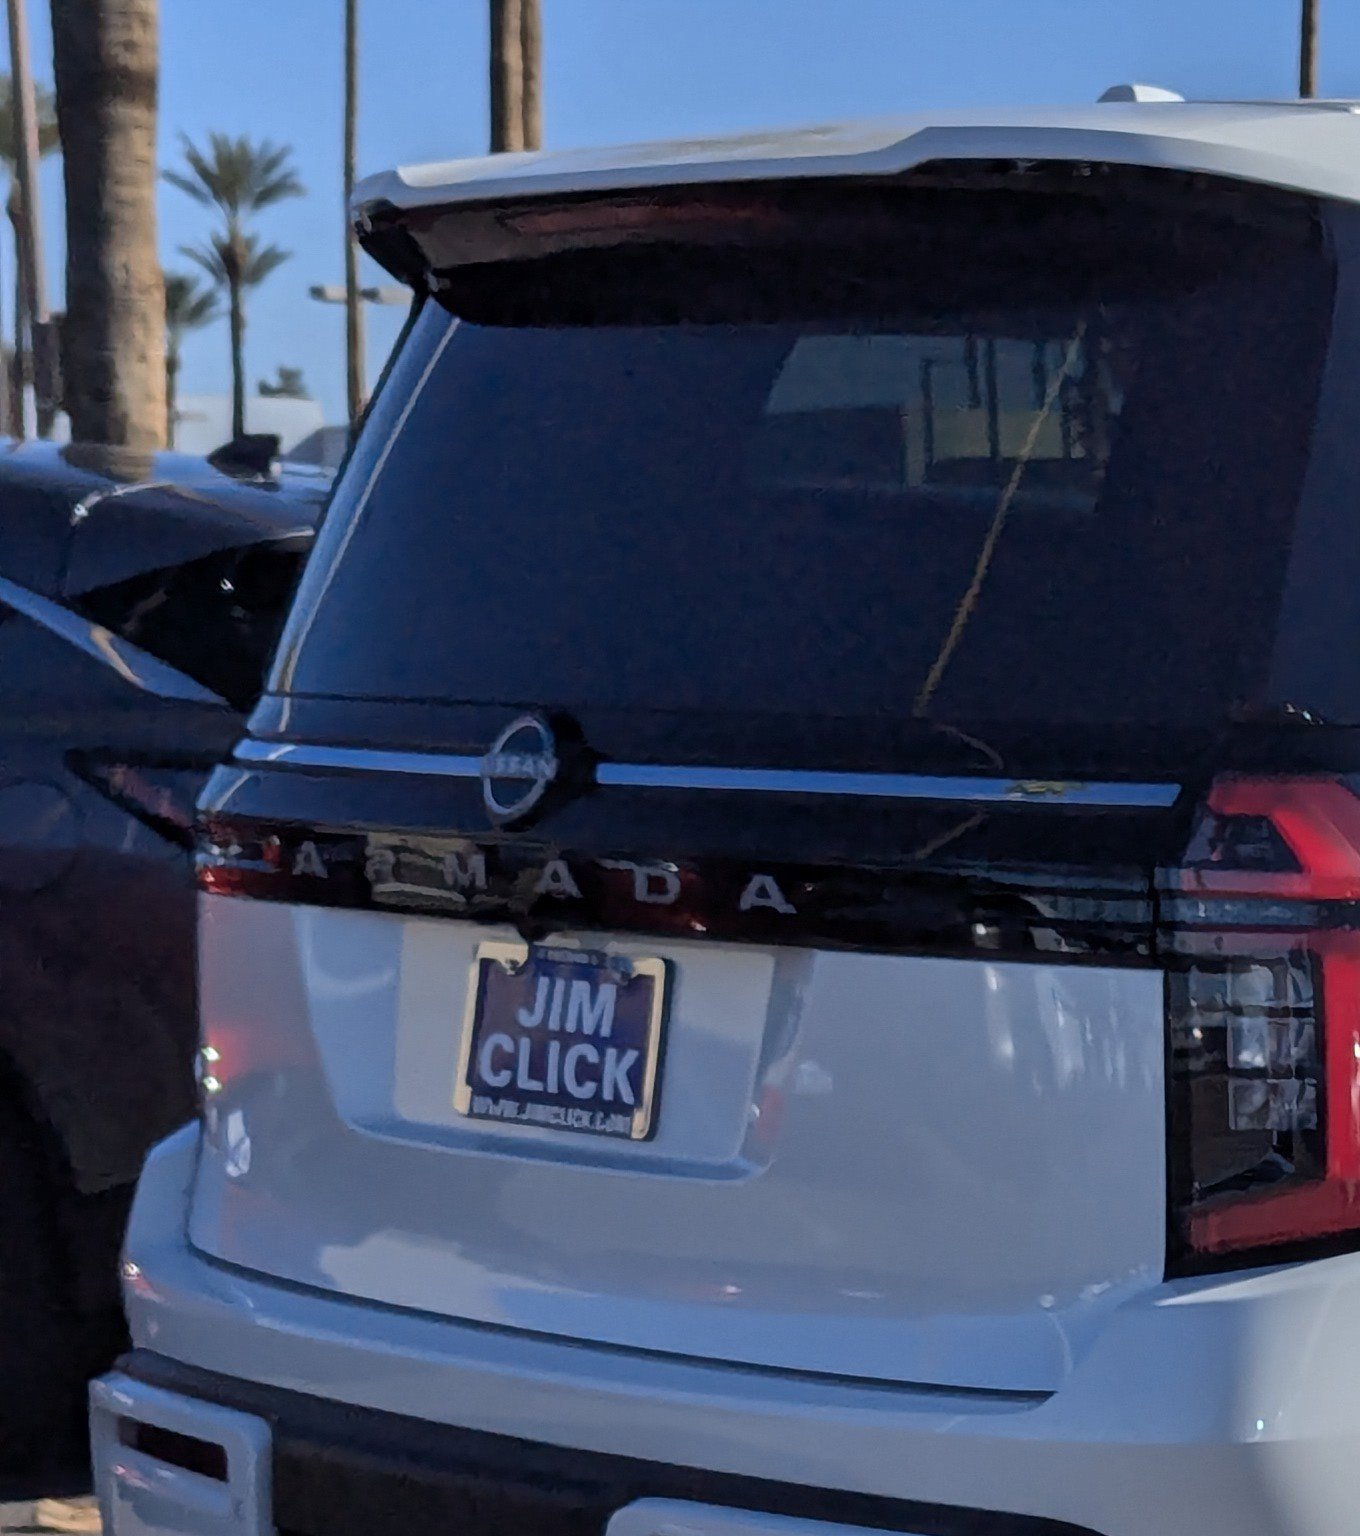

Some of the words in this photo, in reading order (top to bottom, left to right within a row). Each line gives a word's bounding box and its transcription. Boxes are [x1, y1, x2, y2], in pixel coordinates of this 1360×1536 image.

[292, 840, 797, 915] ARMADA
[517, 975, 617, 1038] JIM
[478, 1032, 639, 1106] CLICK
